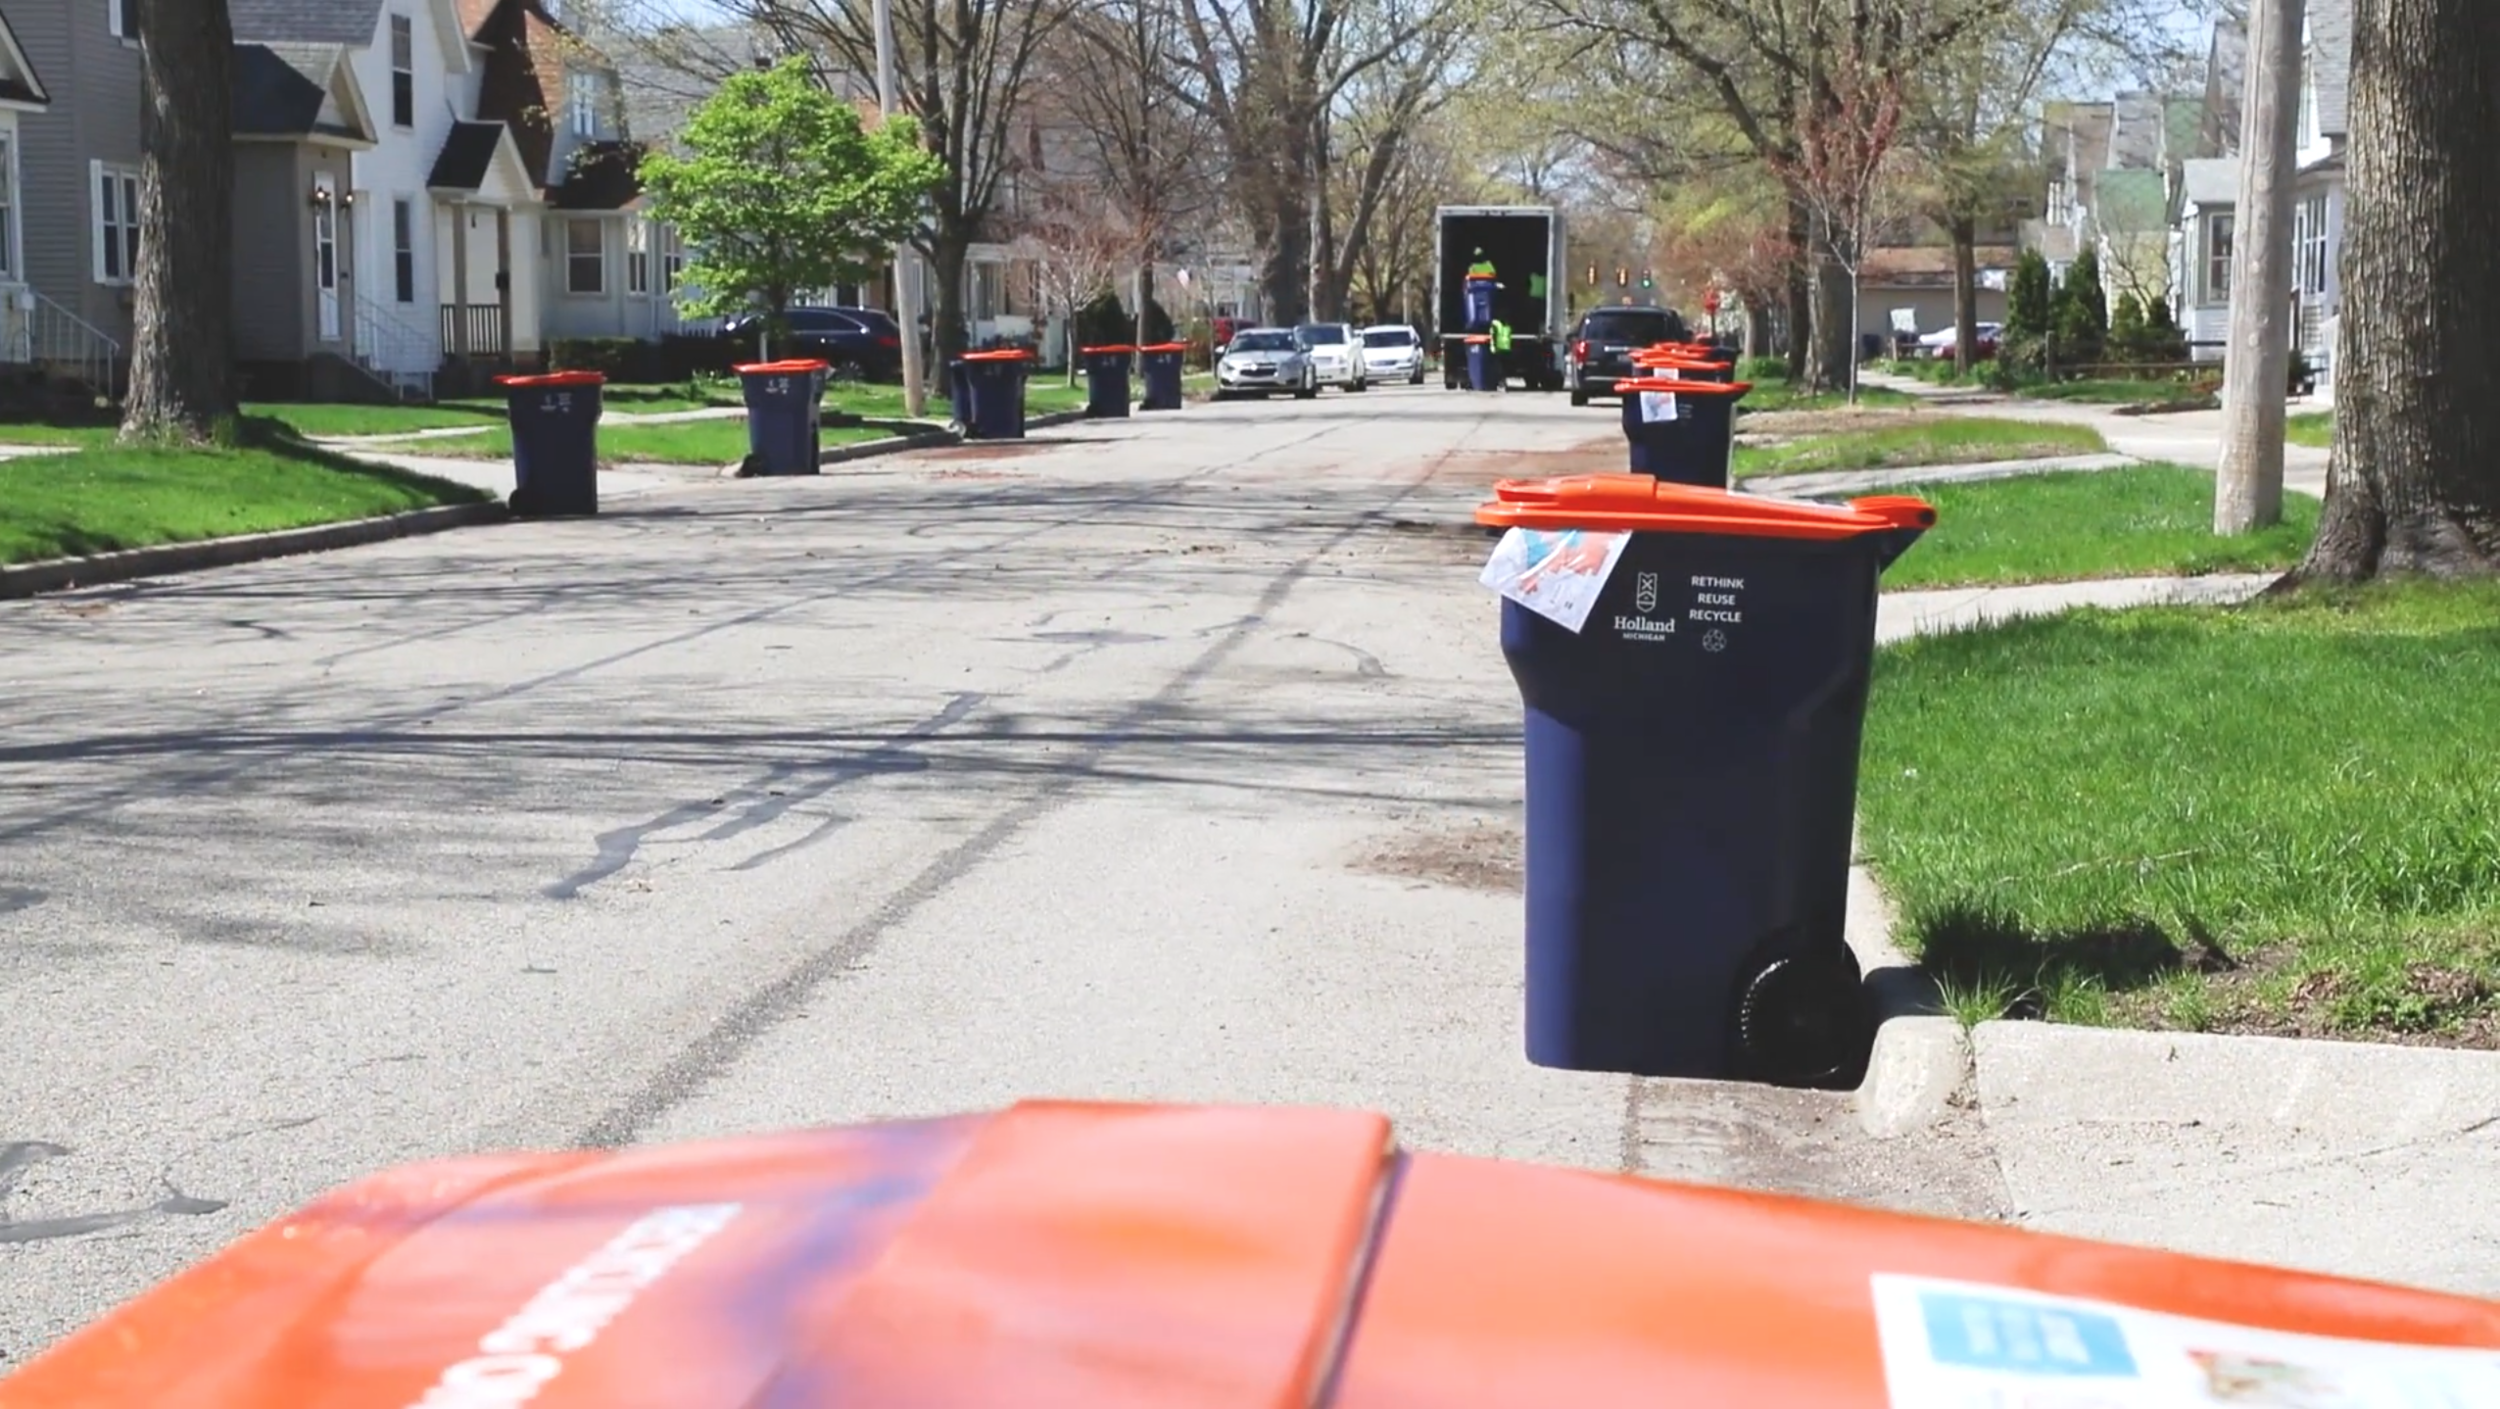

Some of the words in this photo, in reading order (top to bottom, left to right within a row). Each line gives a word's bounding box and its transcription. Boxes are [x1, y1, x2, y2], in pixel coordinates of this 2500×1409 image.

[1691, 575, 1744, 589] RETHINK
[1697, 592, 1736, 606] REUSE
[1689, 608, 1742, 623] RECYCLE
[1613, 615, 1676, 633] Holland
[1622, 632, 1666, 641] MICHIGAN
